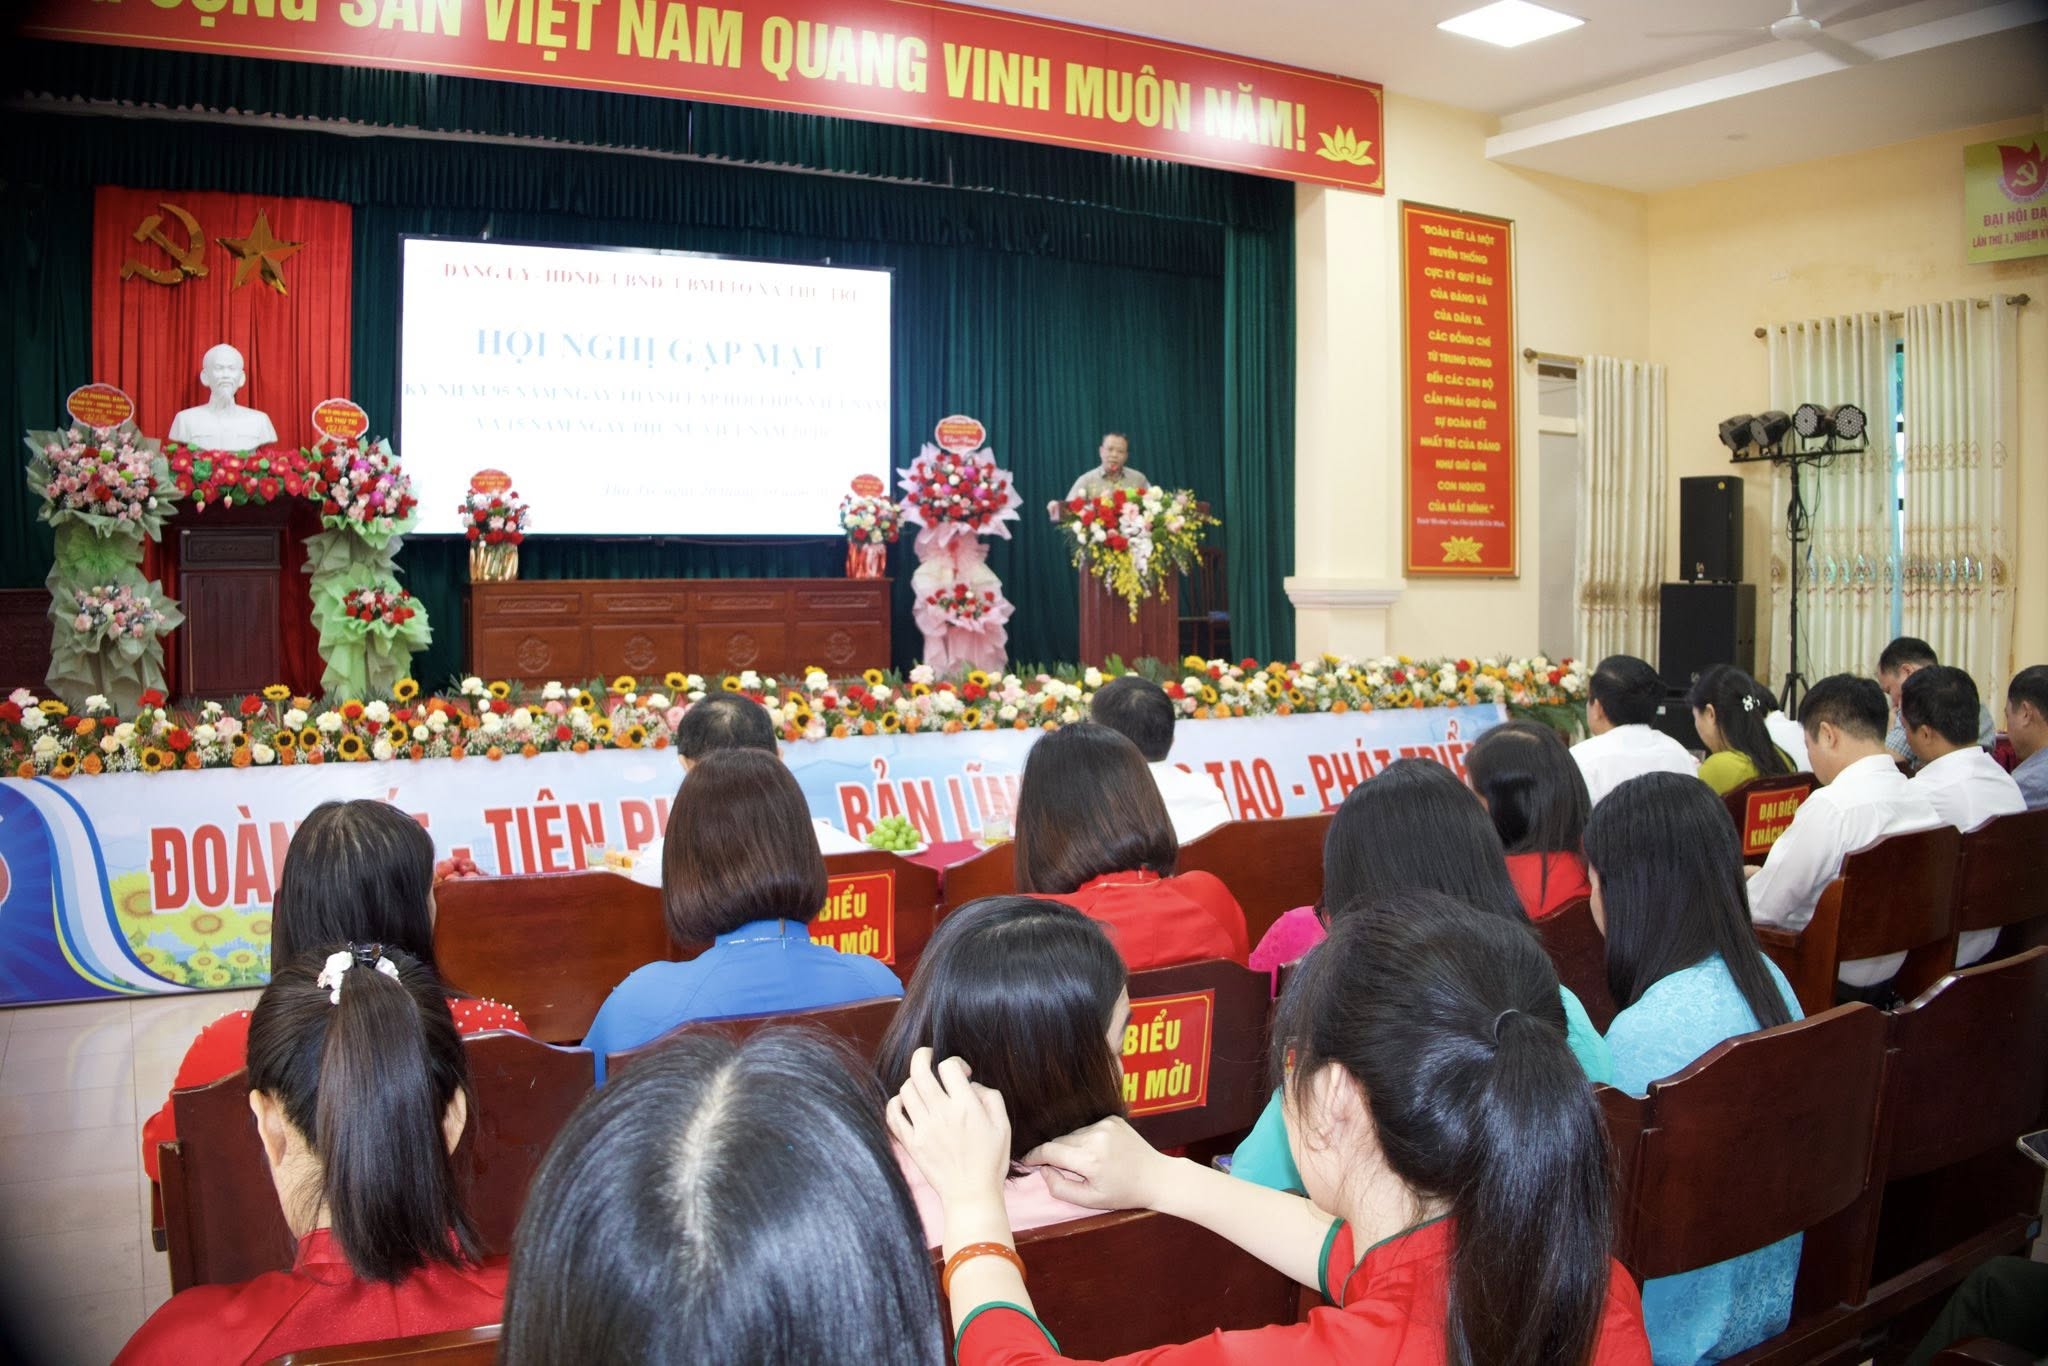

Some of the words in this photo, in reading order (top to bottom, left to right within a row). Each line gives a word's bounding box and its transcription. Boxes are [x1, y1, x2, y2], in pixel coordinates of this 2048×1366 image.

[484, 0, 604, 62] VIỆT
[617, 0, 743, 69] NAM
[761, 16, 927, 93] QUANG
[943, 42, 1050, 111] VINH
[1066, 65, 1191, 133] MUÔN
[1204, 82, 1306, 152] NĂM!
[2031, 207, 2048, 221] ĐẠ
[484, 788, 606, 875] TIÊN
[839, 758, 944, 844] BẢN
[1759, 802, 1778, 823] ĐẠI
[840, 924, 879, 955] MỜI
[1122, 1008, 1181, 1056] BIỂU
[1144, 1059, 1192, 1101] MỜI
